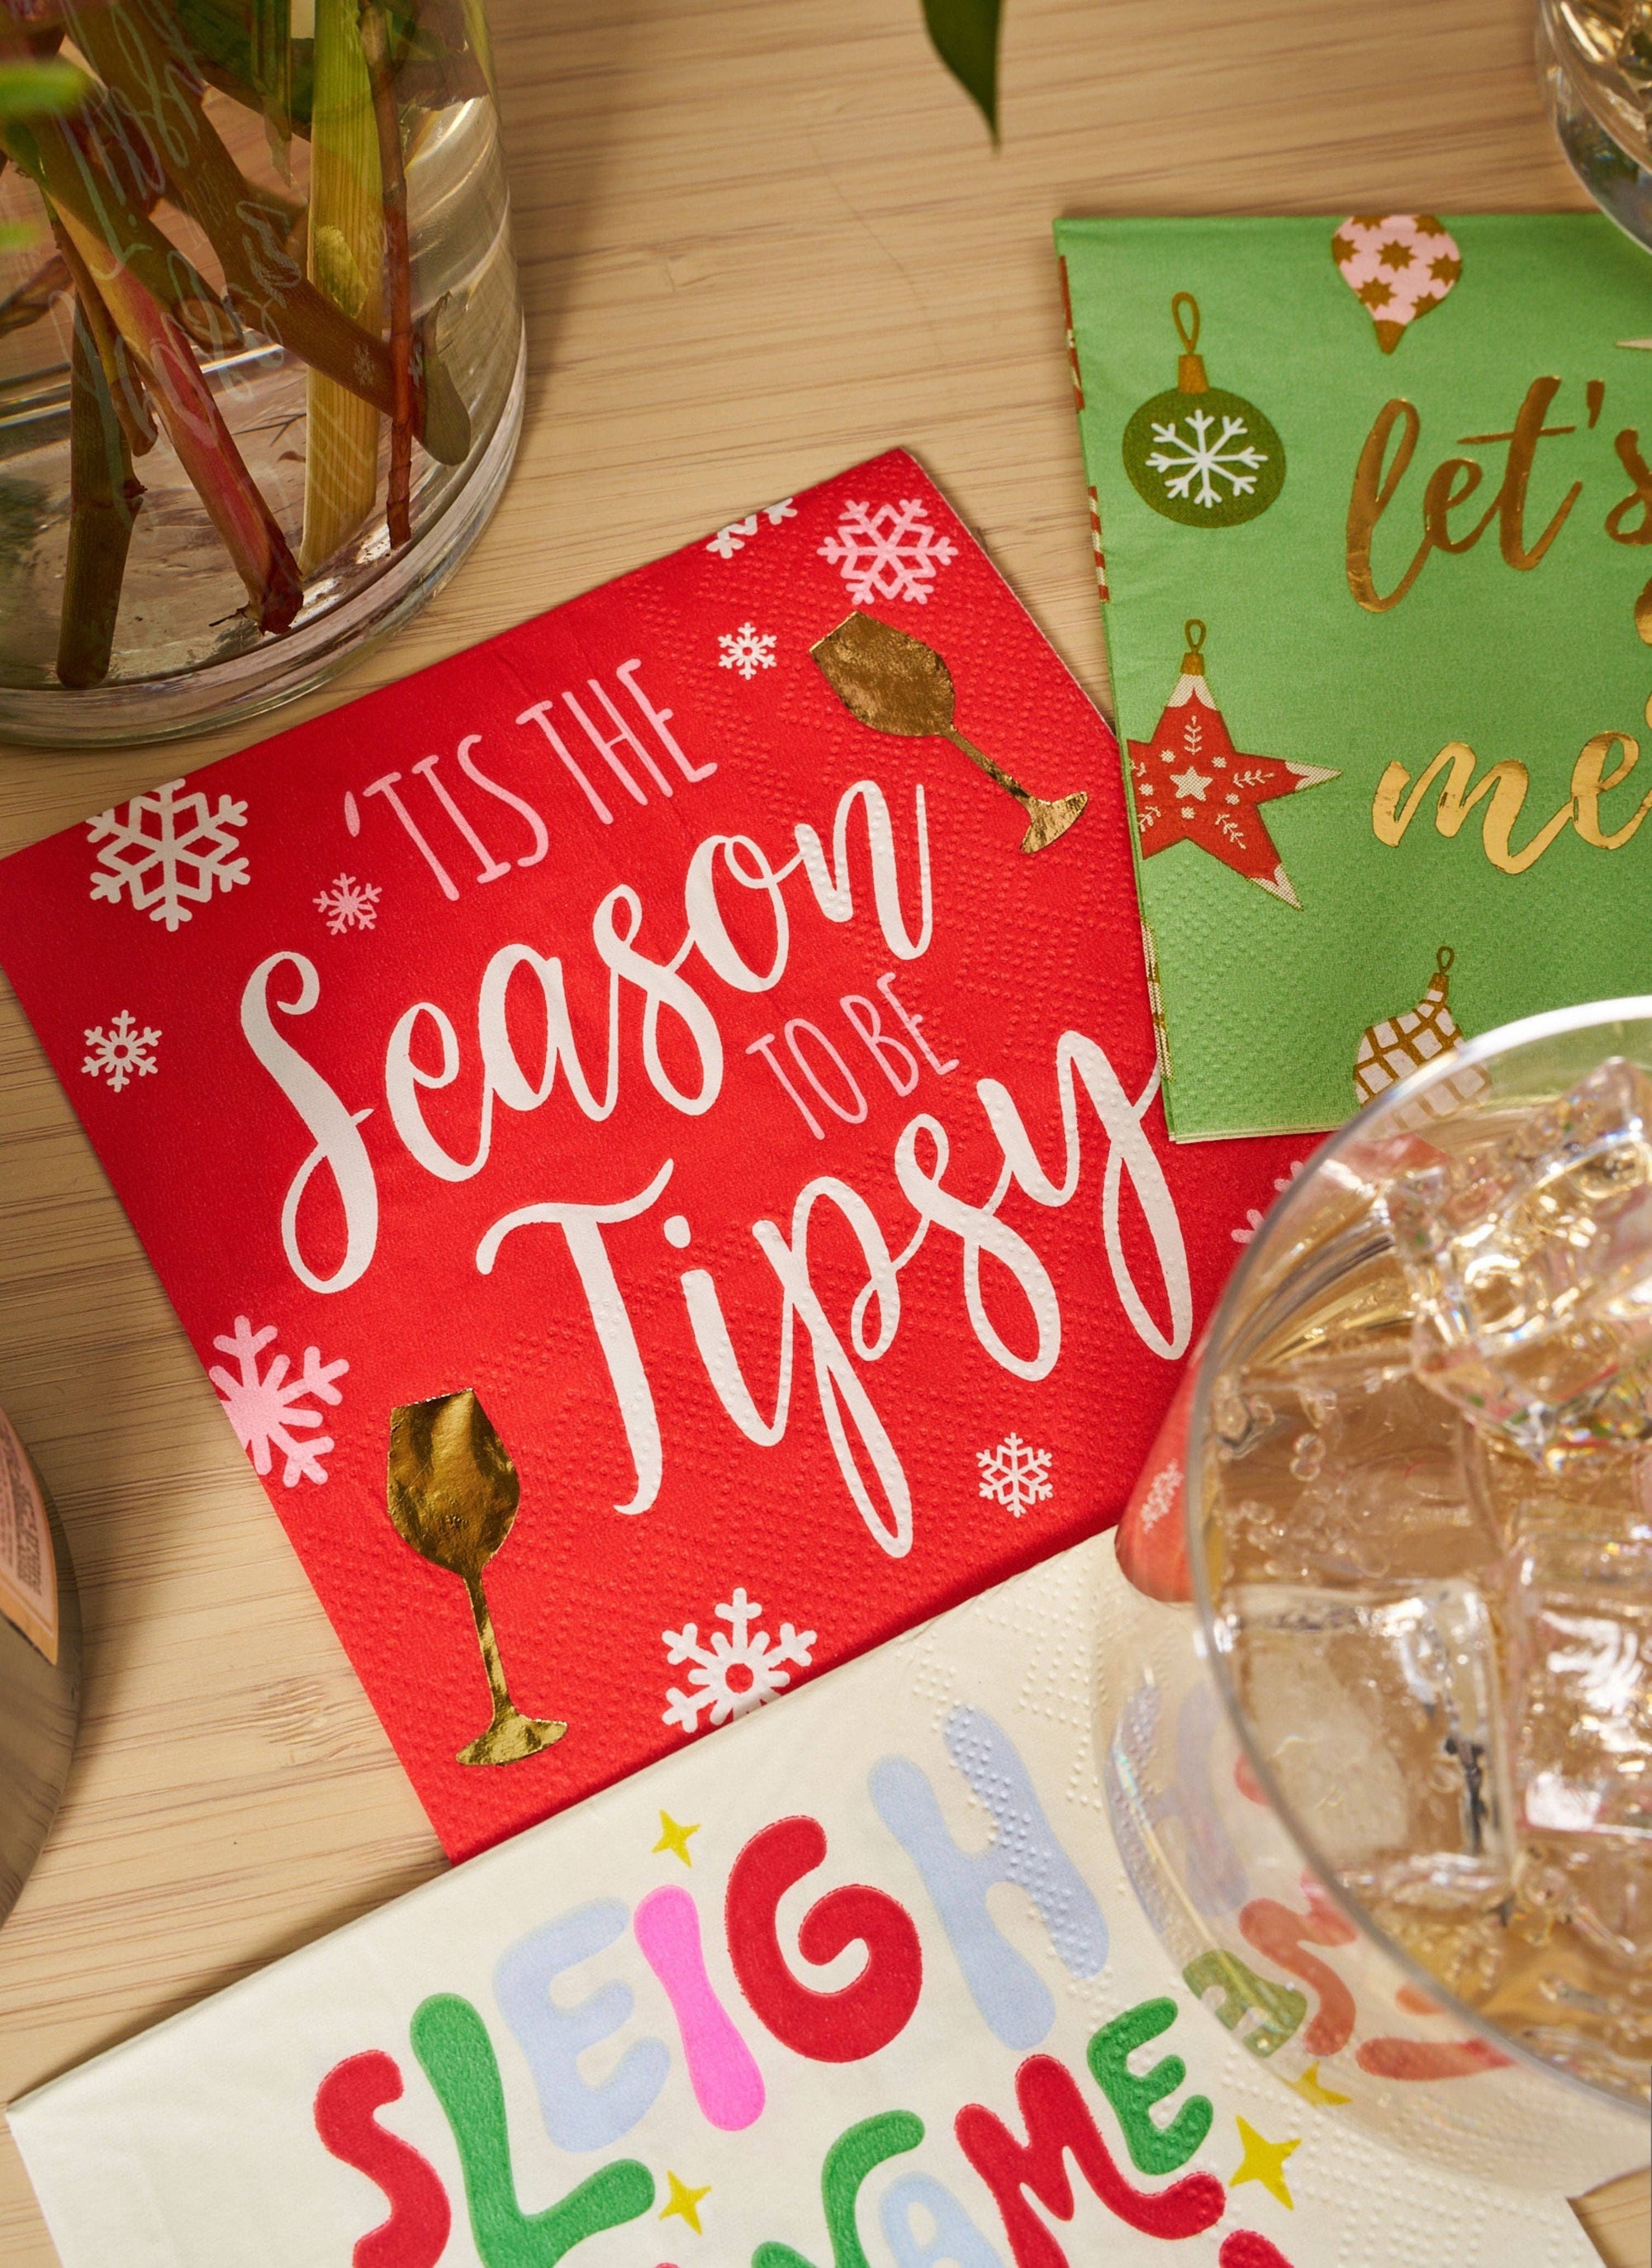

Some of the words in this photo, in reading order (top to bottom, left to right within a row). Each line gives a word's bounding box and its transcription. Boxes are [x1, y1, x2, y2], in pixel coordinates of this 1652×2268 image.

[240, 779, 933, 1294] Season
[344, 734, 549, 901] 'TIS
[515, 658, 718, 826] THE
[474, 1029, 1194, 1559] Tipsy
[745, 1018, 869, 1141] TO
[839, 971, 960, 1098] BE
[313, 1705, 1111, 2268] SLEIGH
